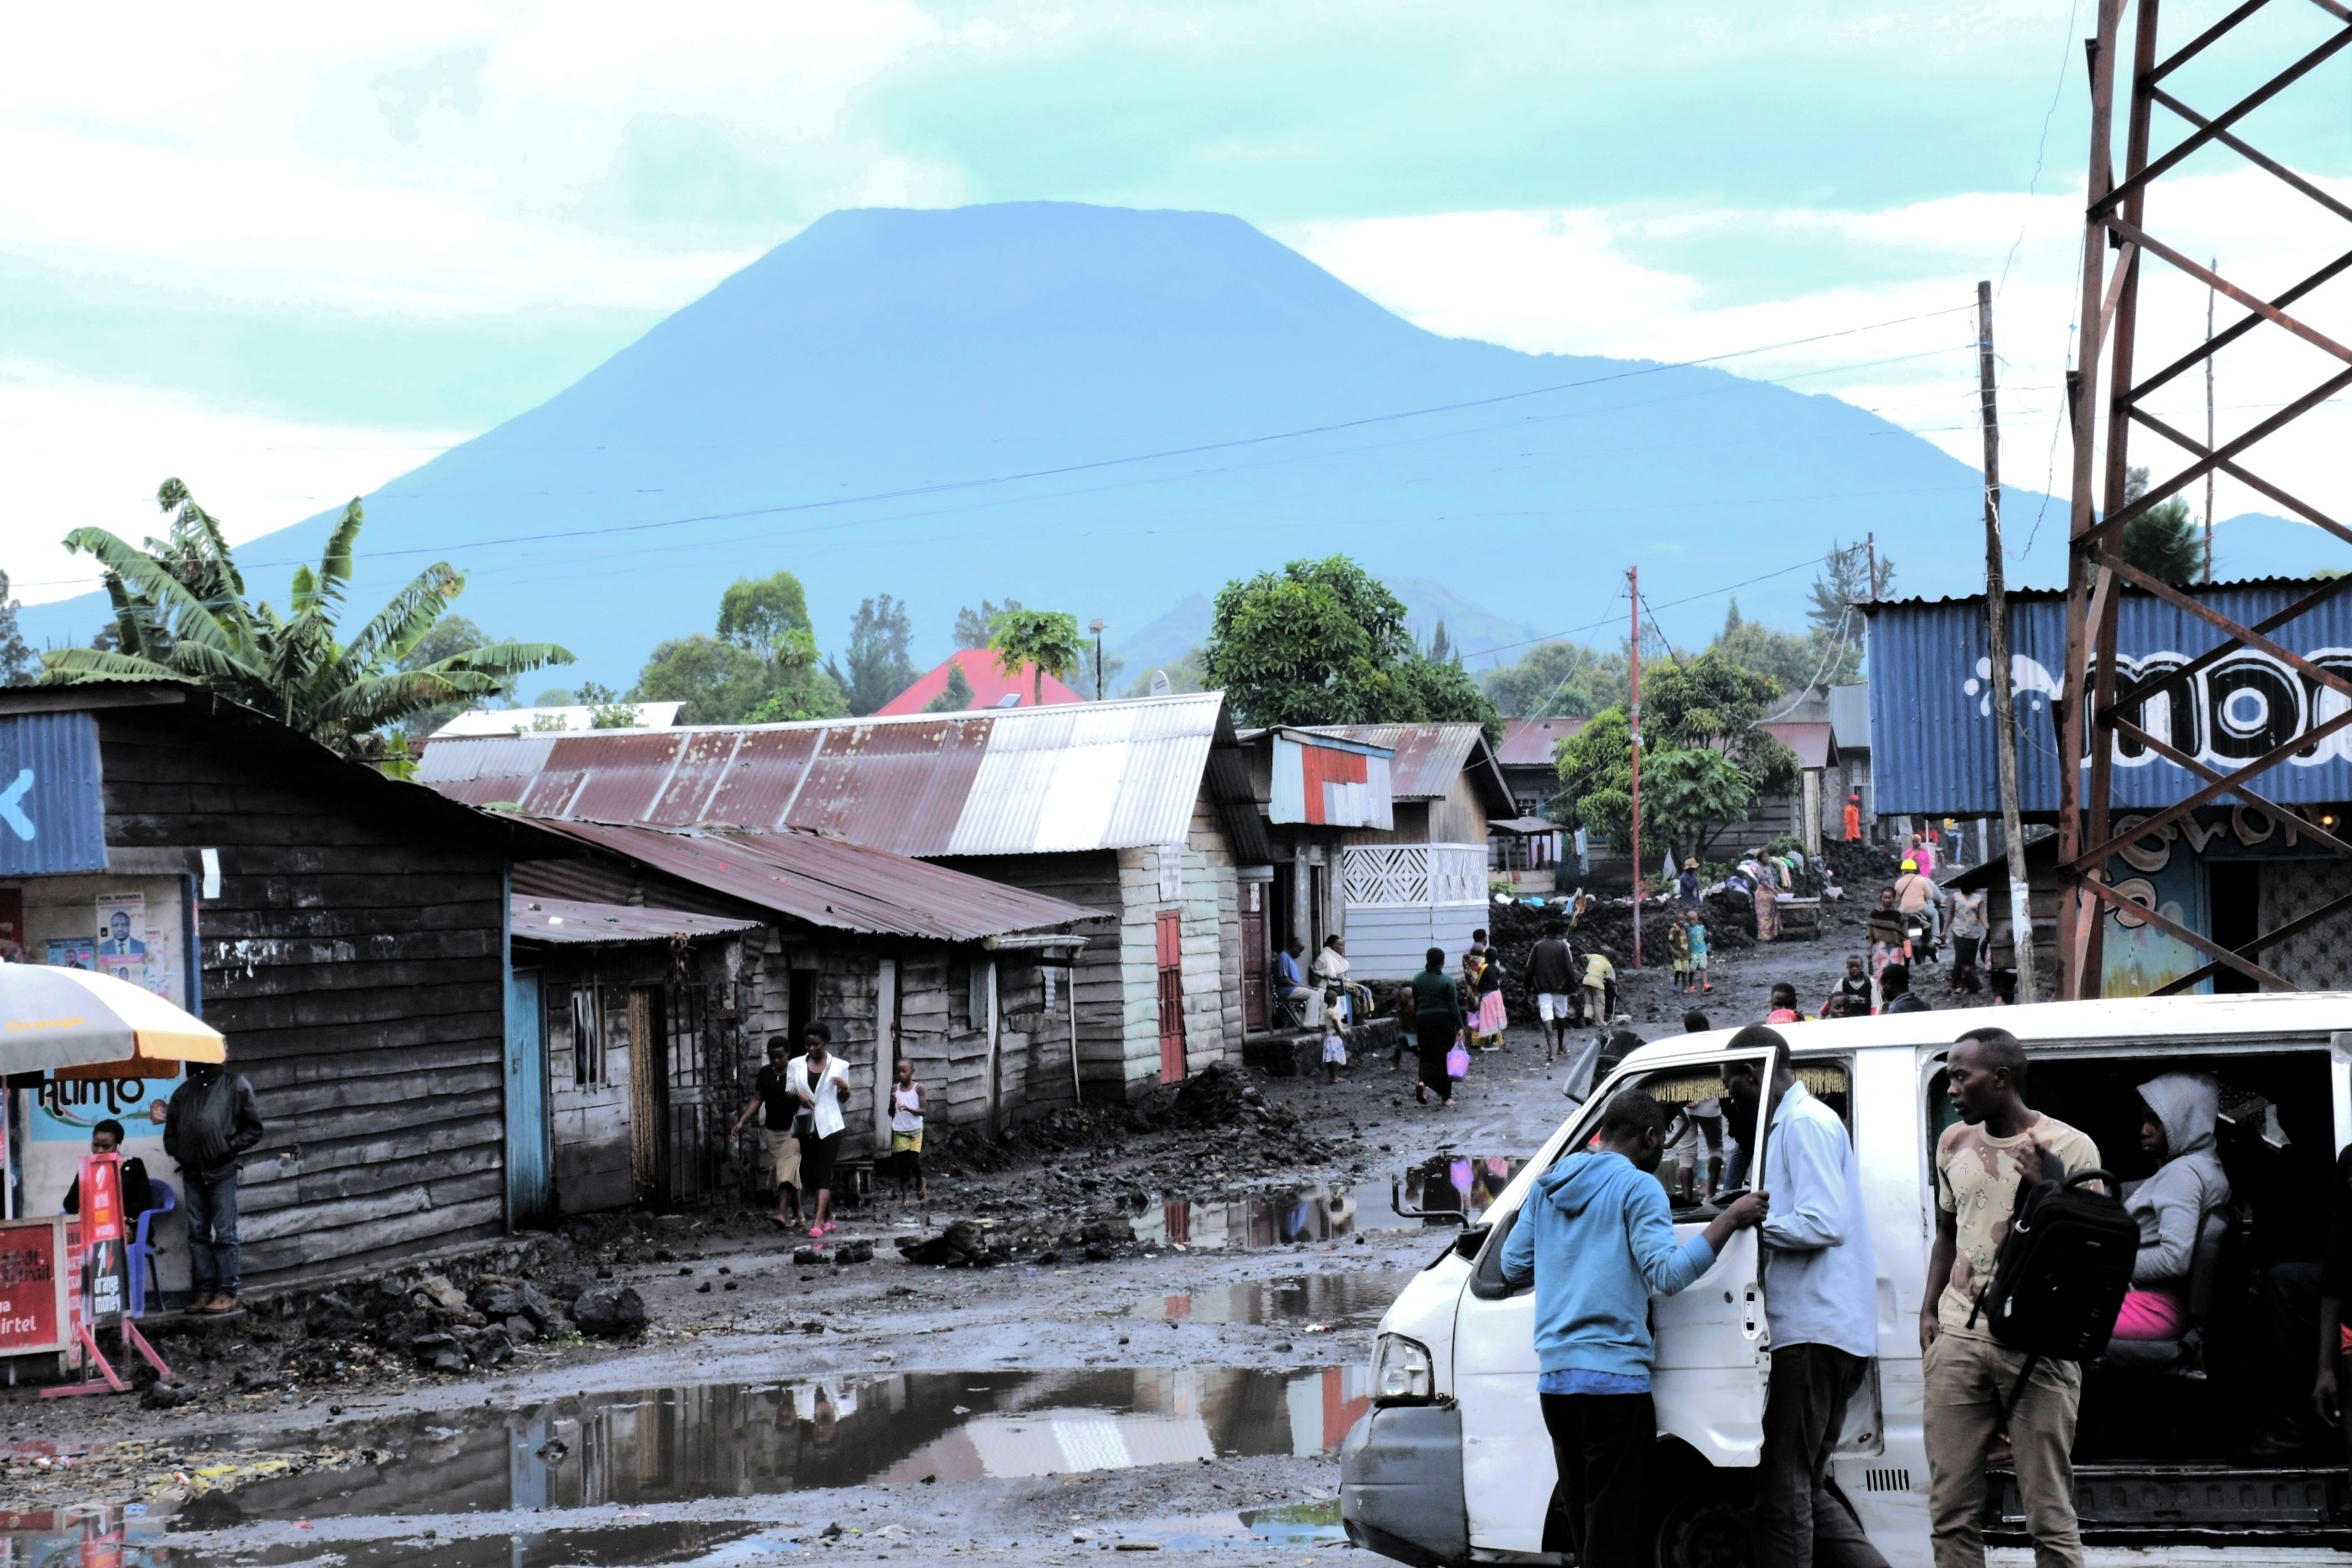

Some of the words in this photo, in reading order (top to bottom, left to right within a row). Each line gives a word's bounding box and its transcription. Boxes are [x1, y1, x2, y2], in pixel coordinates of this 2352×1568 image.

[6, 1016, 85, 1032] Orange
[95, 1275, 119, 1295] orange
[95, 1293, 121, 1314] money
[0, 1315, 37, 1334] irtel
